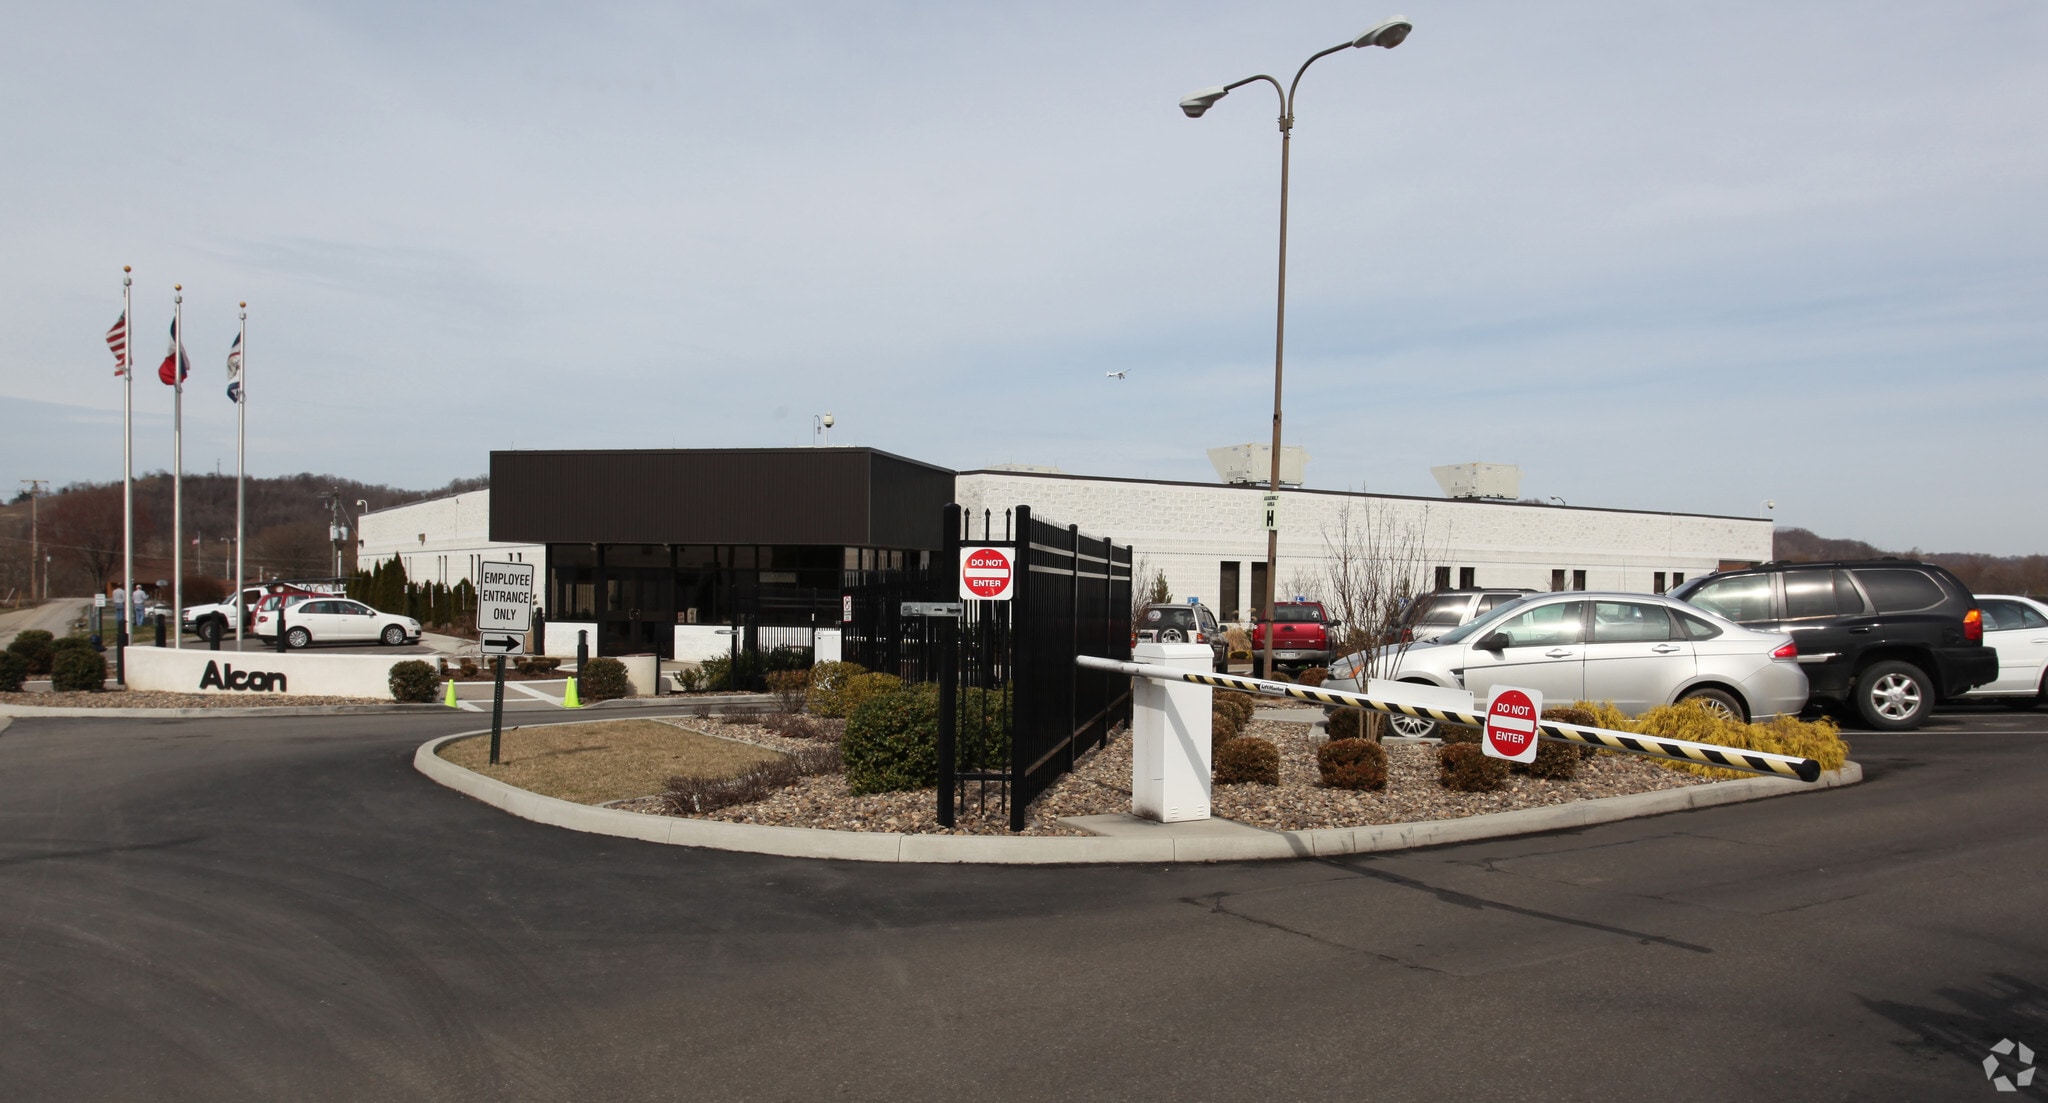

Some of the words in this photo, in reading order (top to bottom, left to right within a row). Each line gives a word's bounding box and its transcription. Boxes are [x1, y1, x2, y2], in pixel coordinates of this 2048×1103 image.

[1266, 509, 1274, 527] H
[971, 559, 984, 567] DO
[985, 559, 1003, 567] NOT
[484, 572, 530, 586] EMPLOYEE
[973, 579, 1001, 587] ENTER
[483, 590, 529, 604] ENTRANCE
[493, 608, 517, 620] ONLY
[199, 659, 287, 692] Alcon
[1497, 703, 1510, 713] DO
[1511, 705, 1530, 716] NOT
[1495, 731, 1525, 744] ENTER
